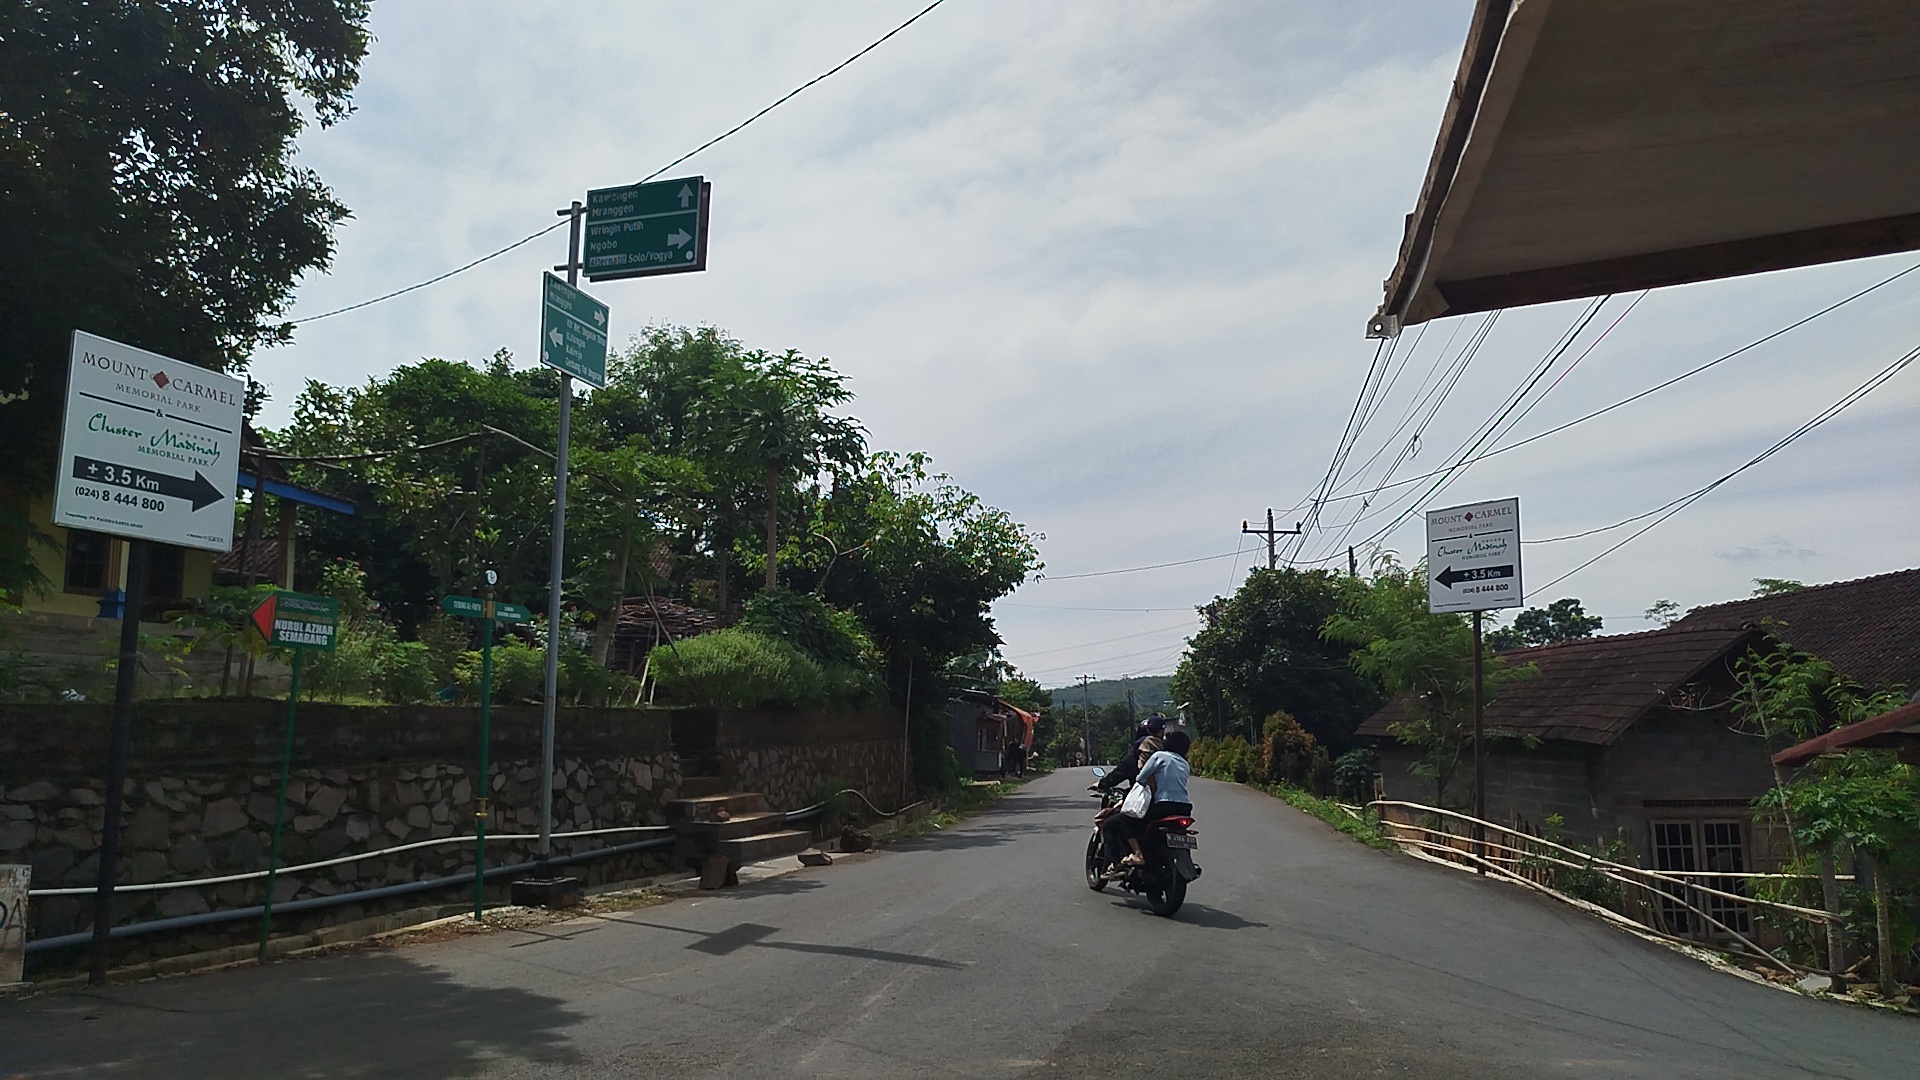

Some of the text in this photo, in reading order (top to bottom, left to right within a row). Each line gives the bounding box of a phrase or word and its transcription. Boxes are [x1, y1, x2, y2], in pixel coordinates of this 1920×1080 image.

[592, 204, 634, 218] Mranggen
[590, 220, 644, 236] Wringin Putih
[590, 240, 618, 252] Ngobo
[628, 250, 674, 265] Solo/Yogya
[82, 352, 236, 406] MOUNT CARMEL
[115, 382, 202, 414] MEMORIAL PARK
[156, 408, 164, 418] &
[88, 412, 221, 467] Cluster Madinah
[138, 445, 210, 468] MEMORIAL PARK
[104, 466, 132, 486] 3.5
[136, 474, 160, 491] Km
[75, 486, 165, 512] (024) 8 444 800
[1431, 506, 1512, 526] MOUNT CARMEL
[1448, 524, 1478, 532] MEMORIAL
[1472, 569, 1486, 580] 3.5
[1487, 570, 1501, 578] Km
[1482, 584, 1494, 592] 444
[1496, 583, 1509, 591] 800
[274, 619, 334, 636] NURUL AZHAR
[278, 630, 328, 646] SEMARANG
